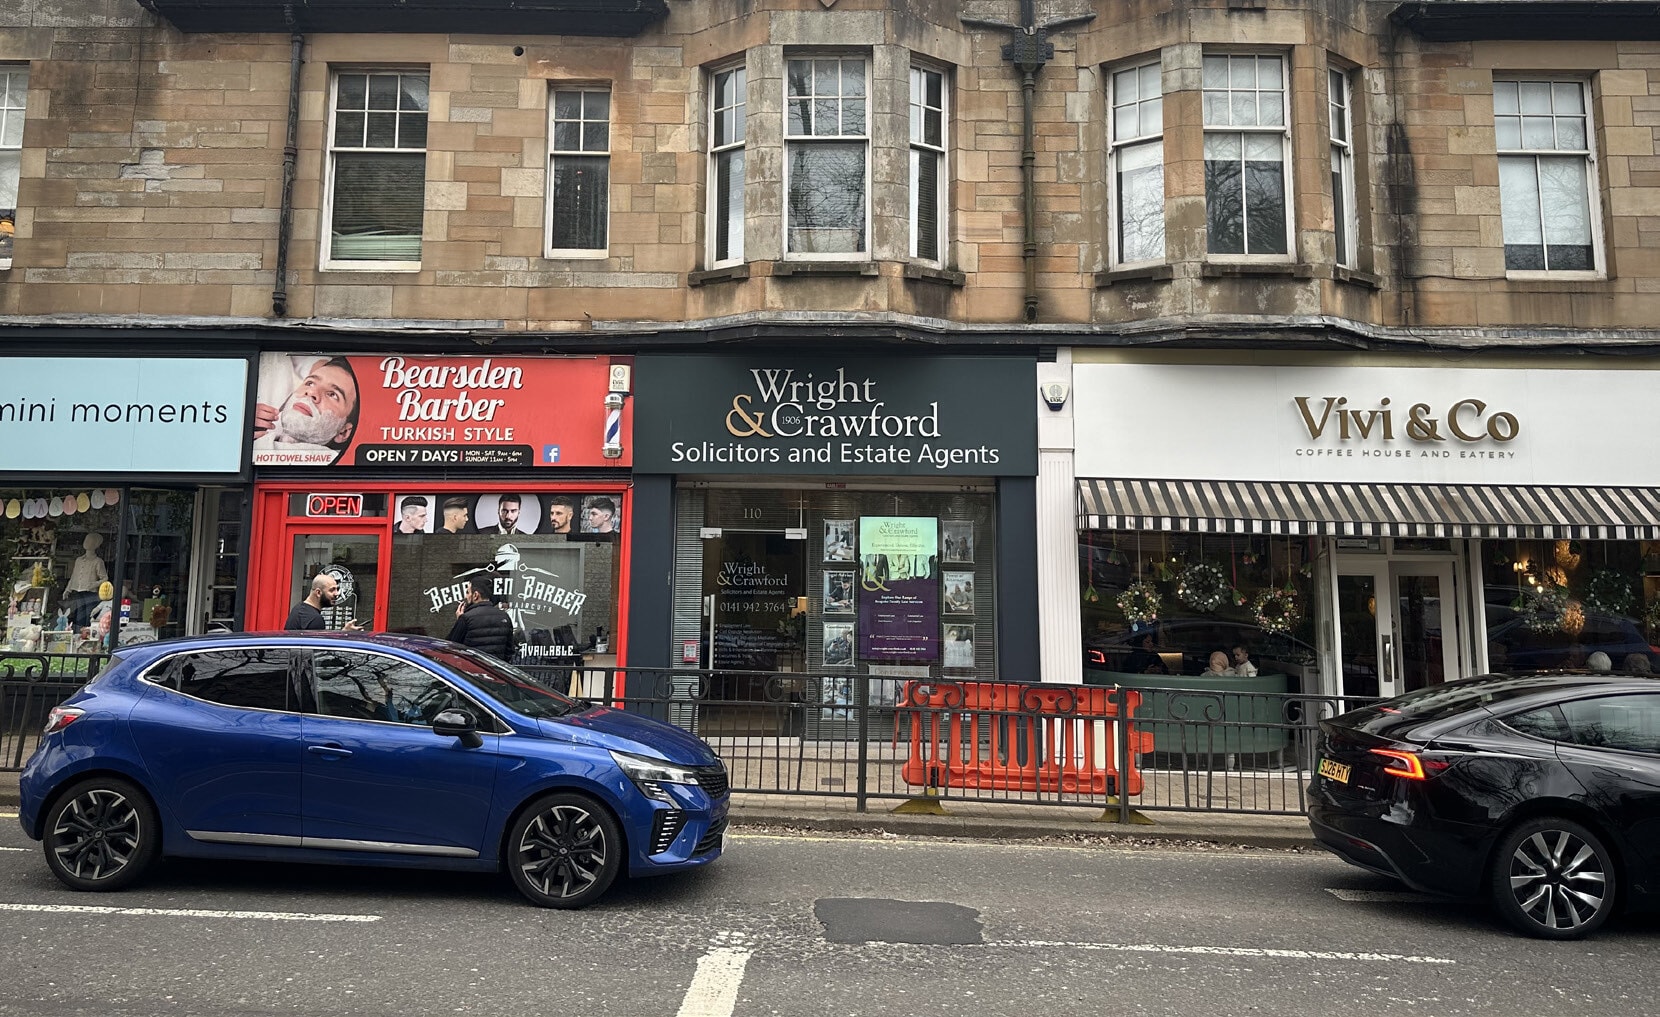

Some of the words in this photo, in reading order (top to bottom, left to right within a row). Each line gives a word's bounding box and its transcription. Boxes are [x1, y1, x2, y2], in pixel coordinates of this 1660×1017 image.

[380, 356, 523, 389] Bearsden
[750, 367, 877, 411] Wright
[71, 401, 228, 423] moments
[396, 388, 505, 422] Barber
[725, 394, 775, 437] &
[771, 402, 942, 438] Crawford
[781, 415, 801, 425] 1906
[1294, 396, 1395, 440] Vivi
[1405, 402, 1447, 442] &
[1447, 398, 1520, 442] Co
[380, 427, 455, 441] TURKISH
[463, 427, 514, 441] STYLE
[256, 454, 274, 462] HOT
[276, 454, 303, 462] TOWEL
[304, 454, 332, 463] SHAVE
[366, 450, 406, 462] OPEN
[410, 450, 419, 462] 7
[421, 450, 458, 462] DAYS
[671, 442, 780, 463] Solicitors
[787, 442, 831, 463] and
[840, 443, 911, 464] Estate
[917, 443, 1000, 469] Agents
[1295, 448, 1353, 457] COFFEE
[1362, 449, 1412, 458] HOUSE
[1420, 450, 1451, 458] AND
[1459, 450, 1516, 459] EATERY
[310, 496, 360, 515] OPEN
[743, 507, 762, 519] 110
[724, 561, 765, 576] Wright
[716, 571, 733, 586] &
[732, 574, 788, 586] Crawford
[517, 573, 587, 616] BARBER
[720, 602, 740, 612] 0141
[743, 602, 760, 612] 942
[764, 602, 785, 613] 3764
[518, 642, 574, 659] AVAILABLE
